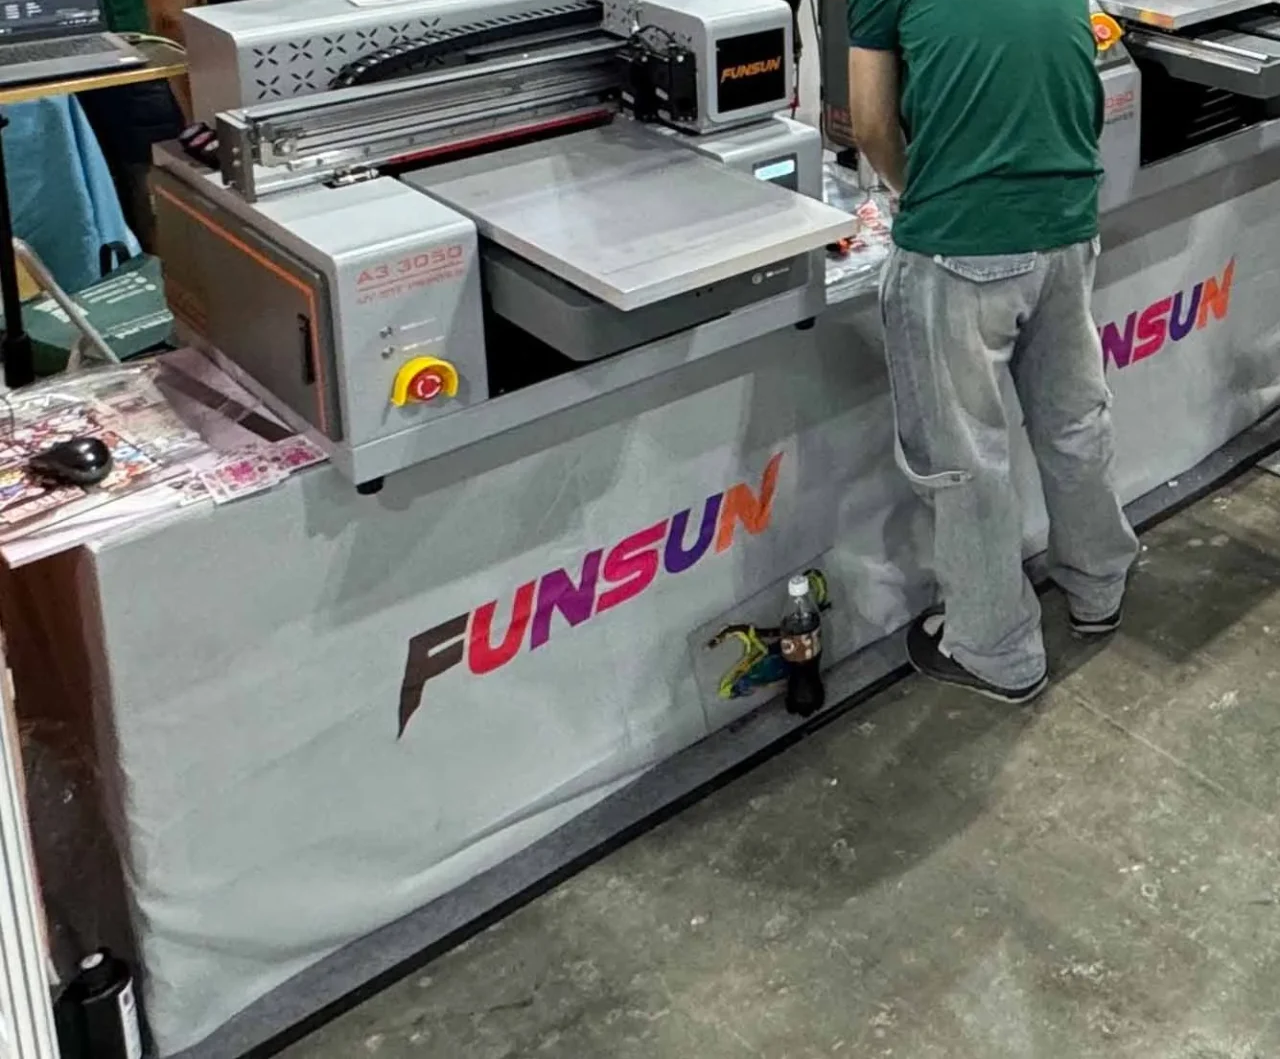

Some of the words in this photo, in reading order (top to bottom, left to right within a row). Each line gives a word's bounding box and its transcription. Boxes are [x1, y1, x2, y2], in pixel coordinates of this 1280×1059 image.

[720, 55, 782, 84] FUNSUN
[357, 264, 389, 285] A3
[398, 244, 464, 273] 3050
[397, 451, 785, 739] FUNSUN
